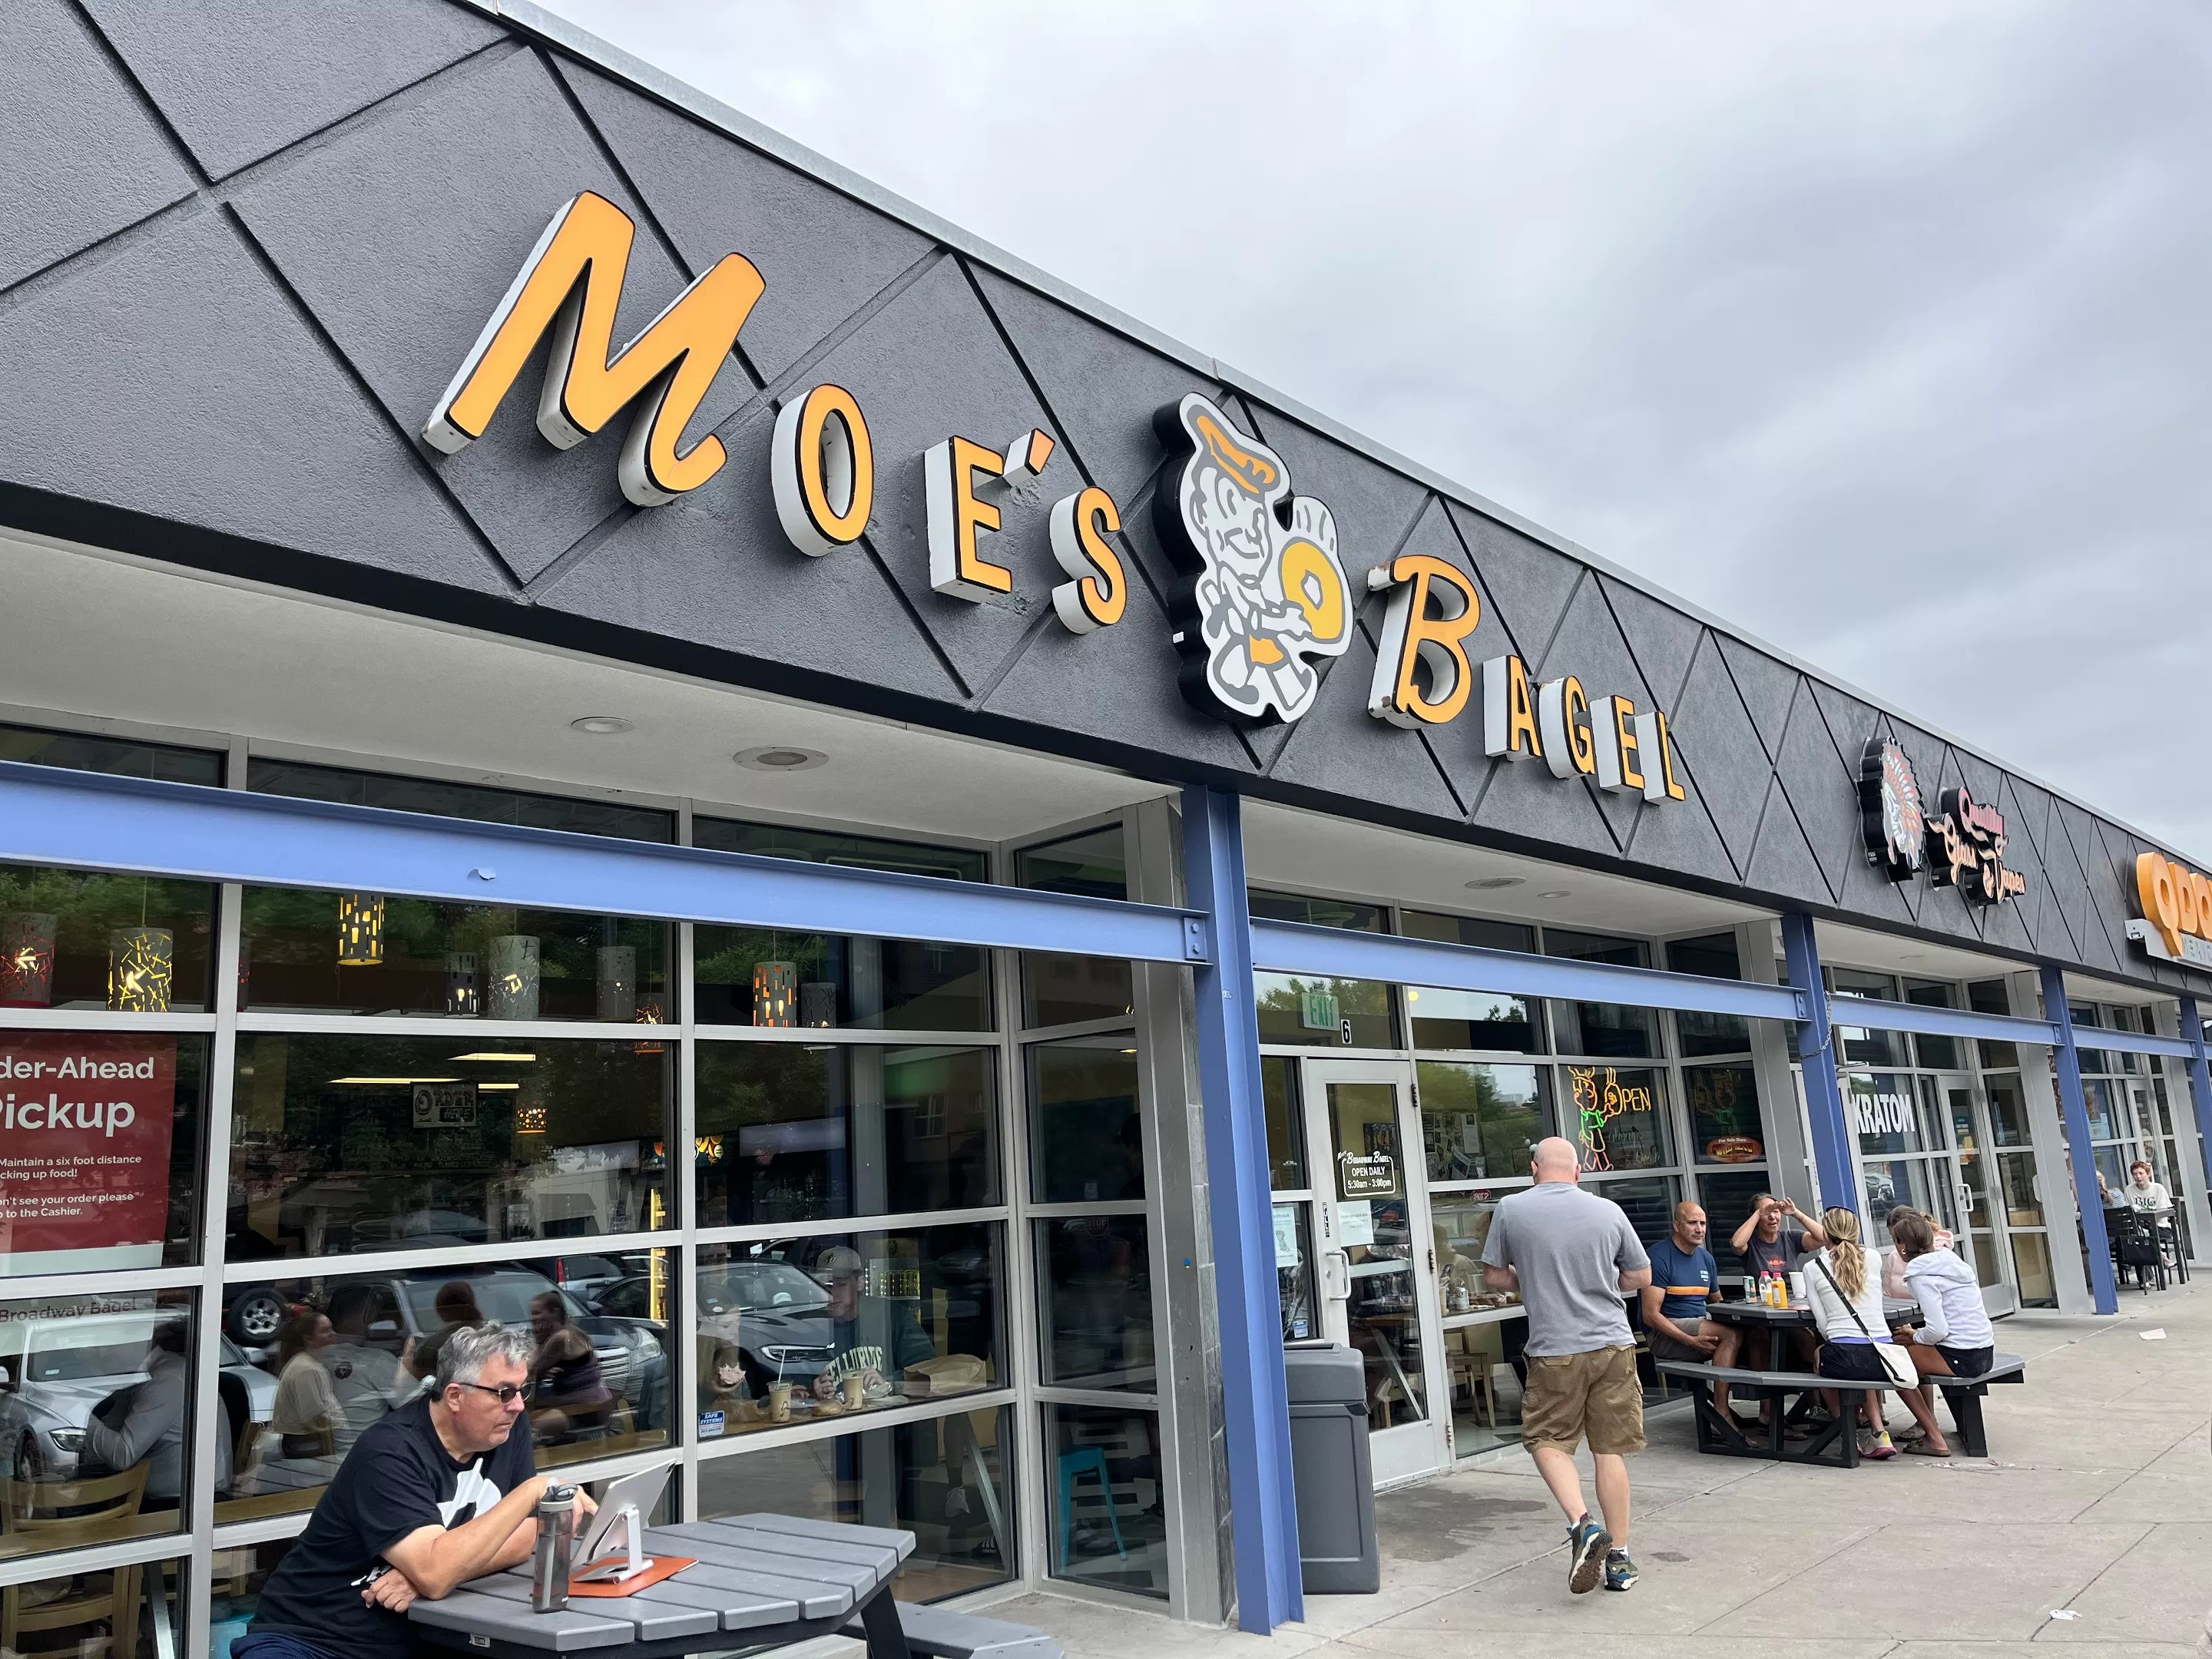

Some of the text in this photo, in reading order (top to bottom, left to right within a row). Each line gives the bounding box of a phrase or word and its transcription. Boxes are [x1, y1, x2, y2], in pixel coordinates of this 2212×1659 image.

[1368, 554, 1686, 806] BAGEL
[2137, 852, 2212, 957] QDO
[1308, 995, 1335, 1027] EXIT
[1343, 1020, 1350, 1044] 6
[1604, 1082, 1651, 1115] OPEN
[0, 1093, 135, 1137] ickup
[1852, 1093, 1916, 1134] KRATOM
[0, 1157, 45, 1167] Maintain
[56, 1157, 71, 1166] six
[73, 1156, 94, 1165] foot
[97, 1155, 142, 1165] distance
[1352, 1166, 1386, 1177] OPEN DAILY
[32, 1171, 47, 1181] up
[50, 1168, 78, 1178] food!
[1347, 1179, 1368, 1189] 5:30am
[1371, 1177, 1392, 1189] 3:00pm
[19, 1197, 38, 1206] see
[41, 1196, 65, 1207] your
[67, 1194, 97, 1204] order
[98, 1193, 134, 1204] please
[2134, 1197, 2156, 1207] BIG
[6, 1209, 17, 1218] to
[20, 1208, 38, 1217] the
[41, 1207, 83, 1217] Cashier.
[0, 1296, 137, 1323] Broadway Bagel
[828, 1346, 883, 1387] ELLURIDE
[700, 1417, 724, 1426] SYSTEMS
